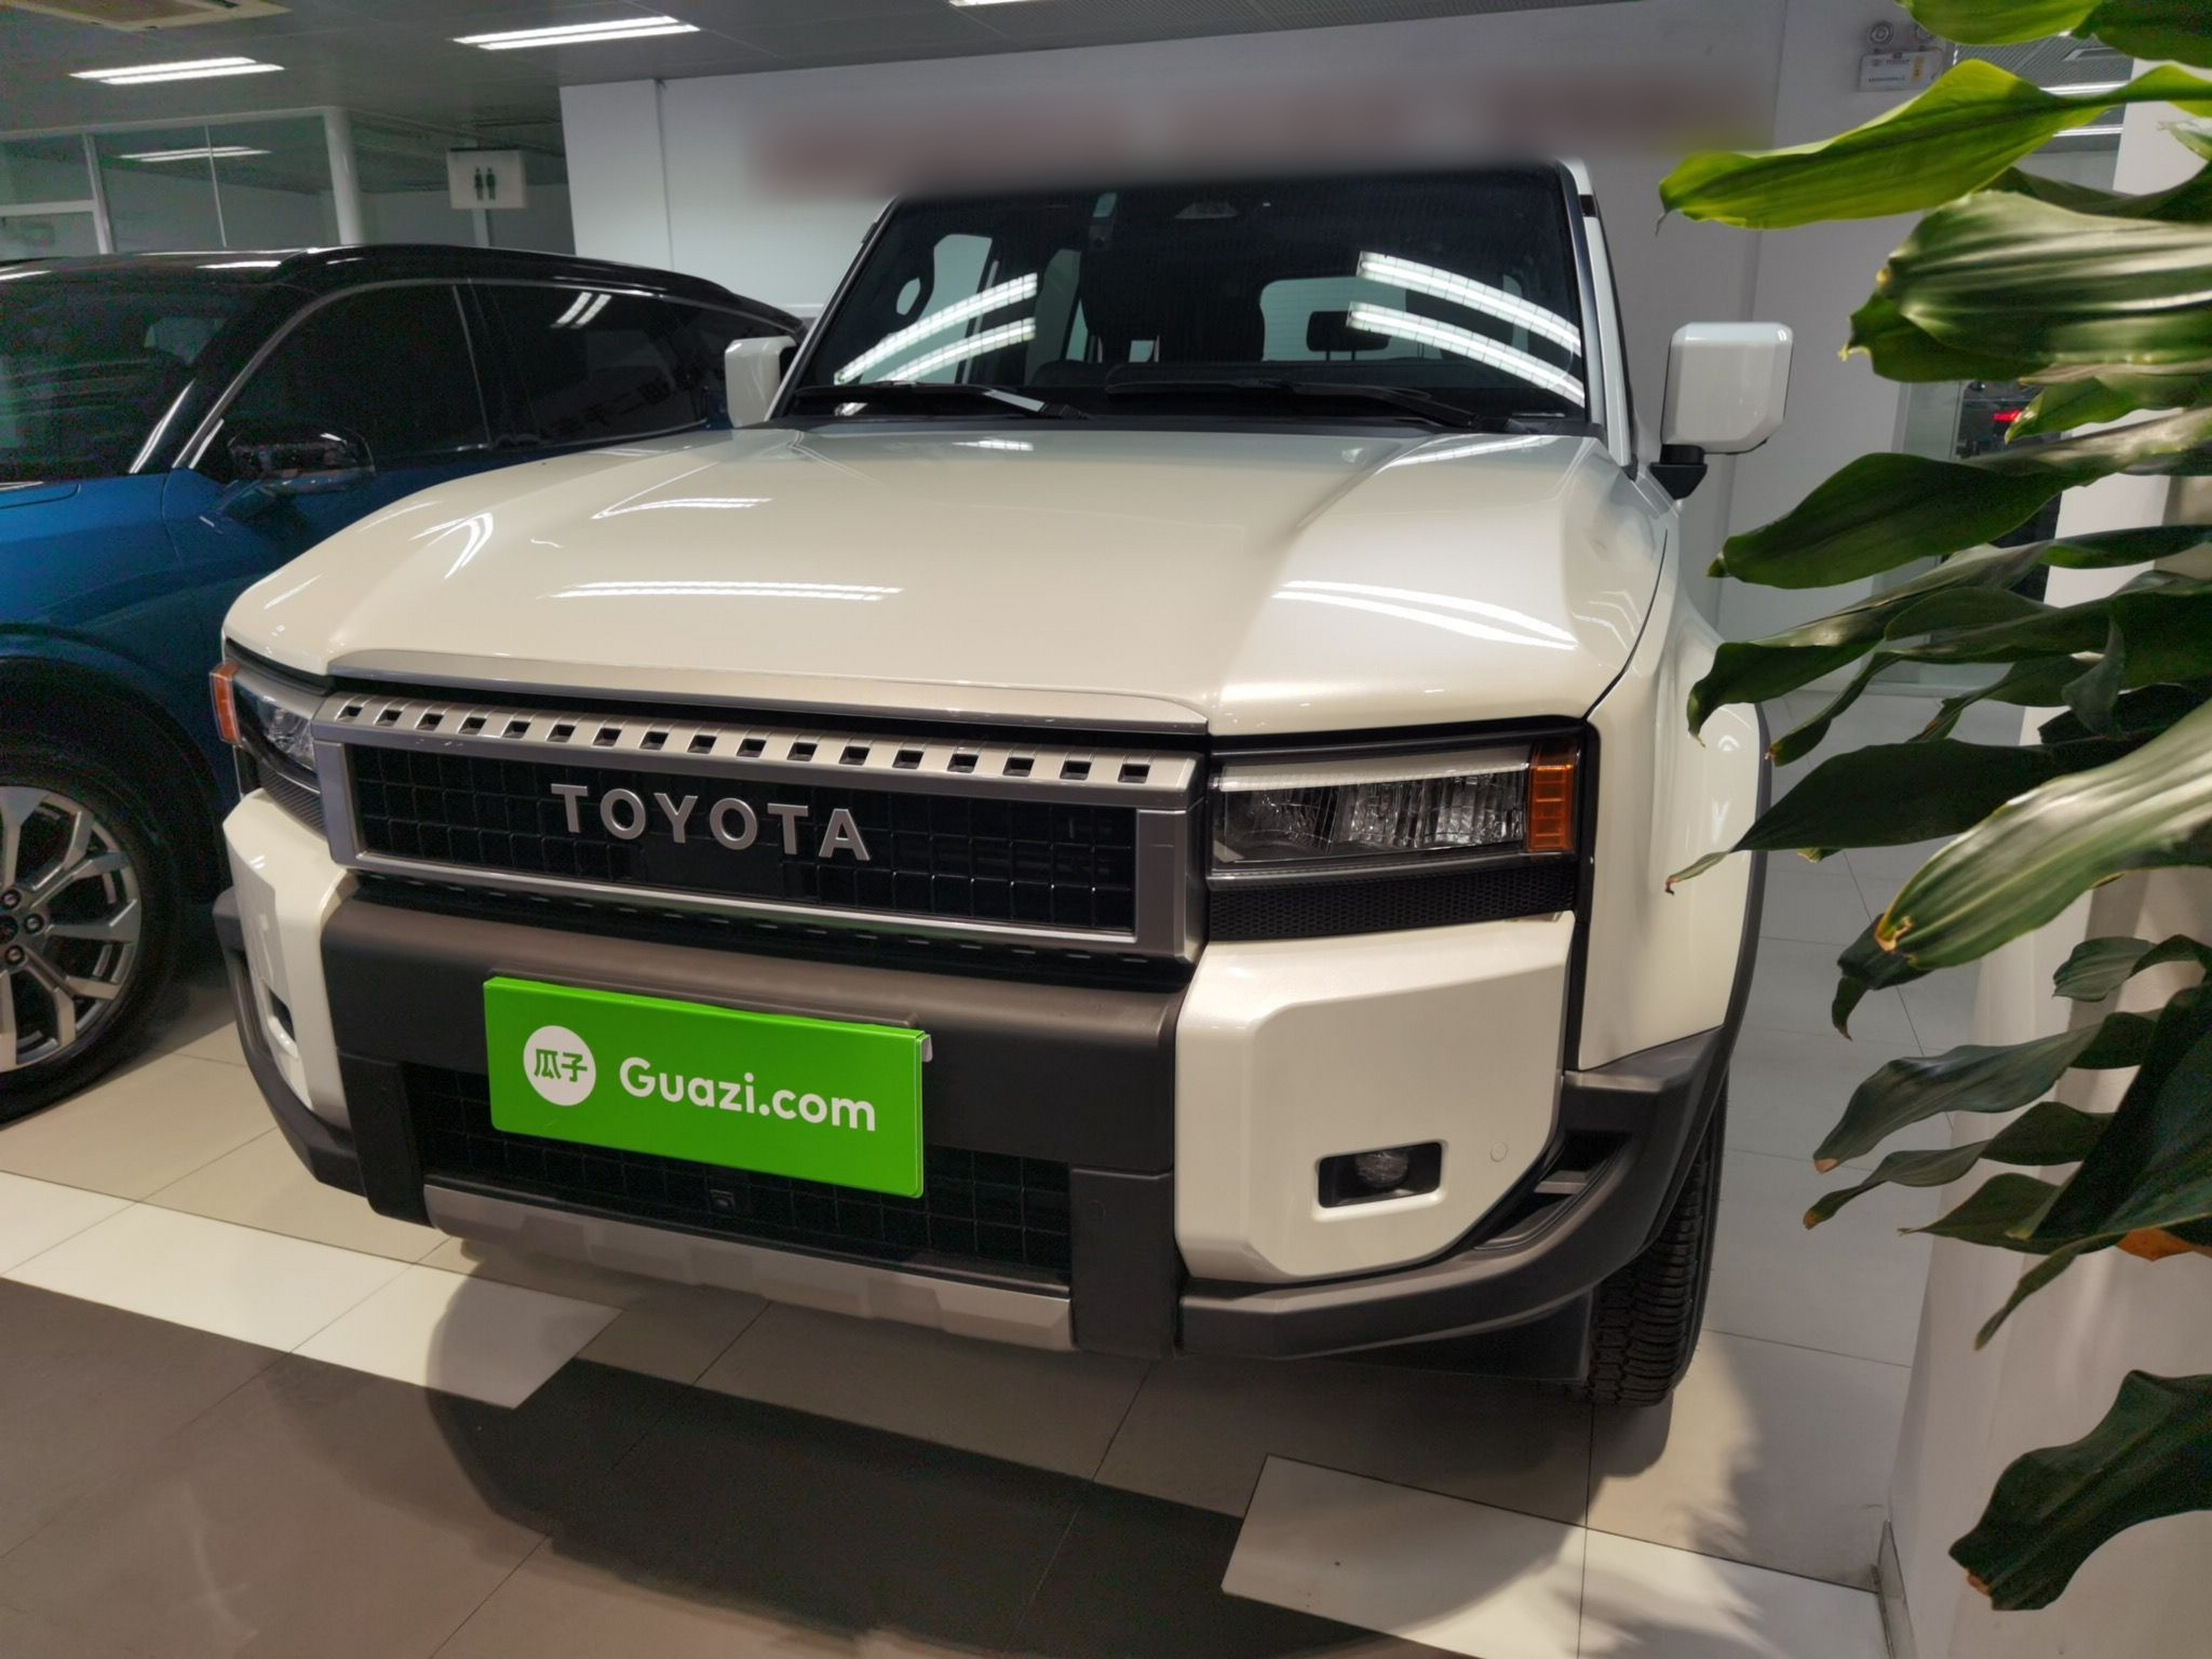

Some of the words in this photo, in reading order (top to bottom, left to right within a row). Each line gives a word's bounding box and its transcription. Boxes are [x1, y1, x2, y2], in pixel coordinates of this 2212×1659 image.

[551, 783, 870, 861] TOYOTA
[533, 1048, 588, 1082] 瓜子
[619, 1056, 876, 1131] Guazi.com
